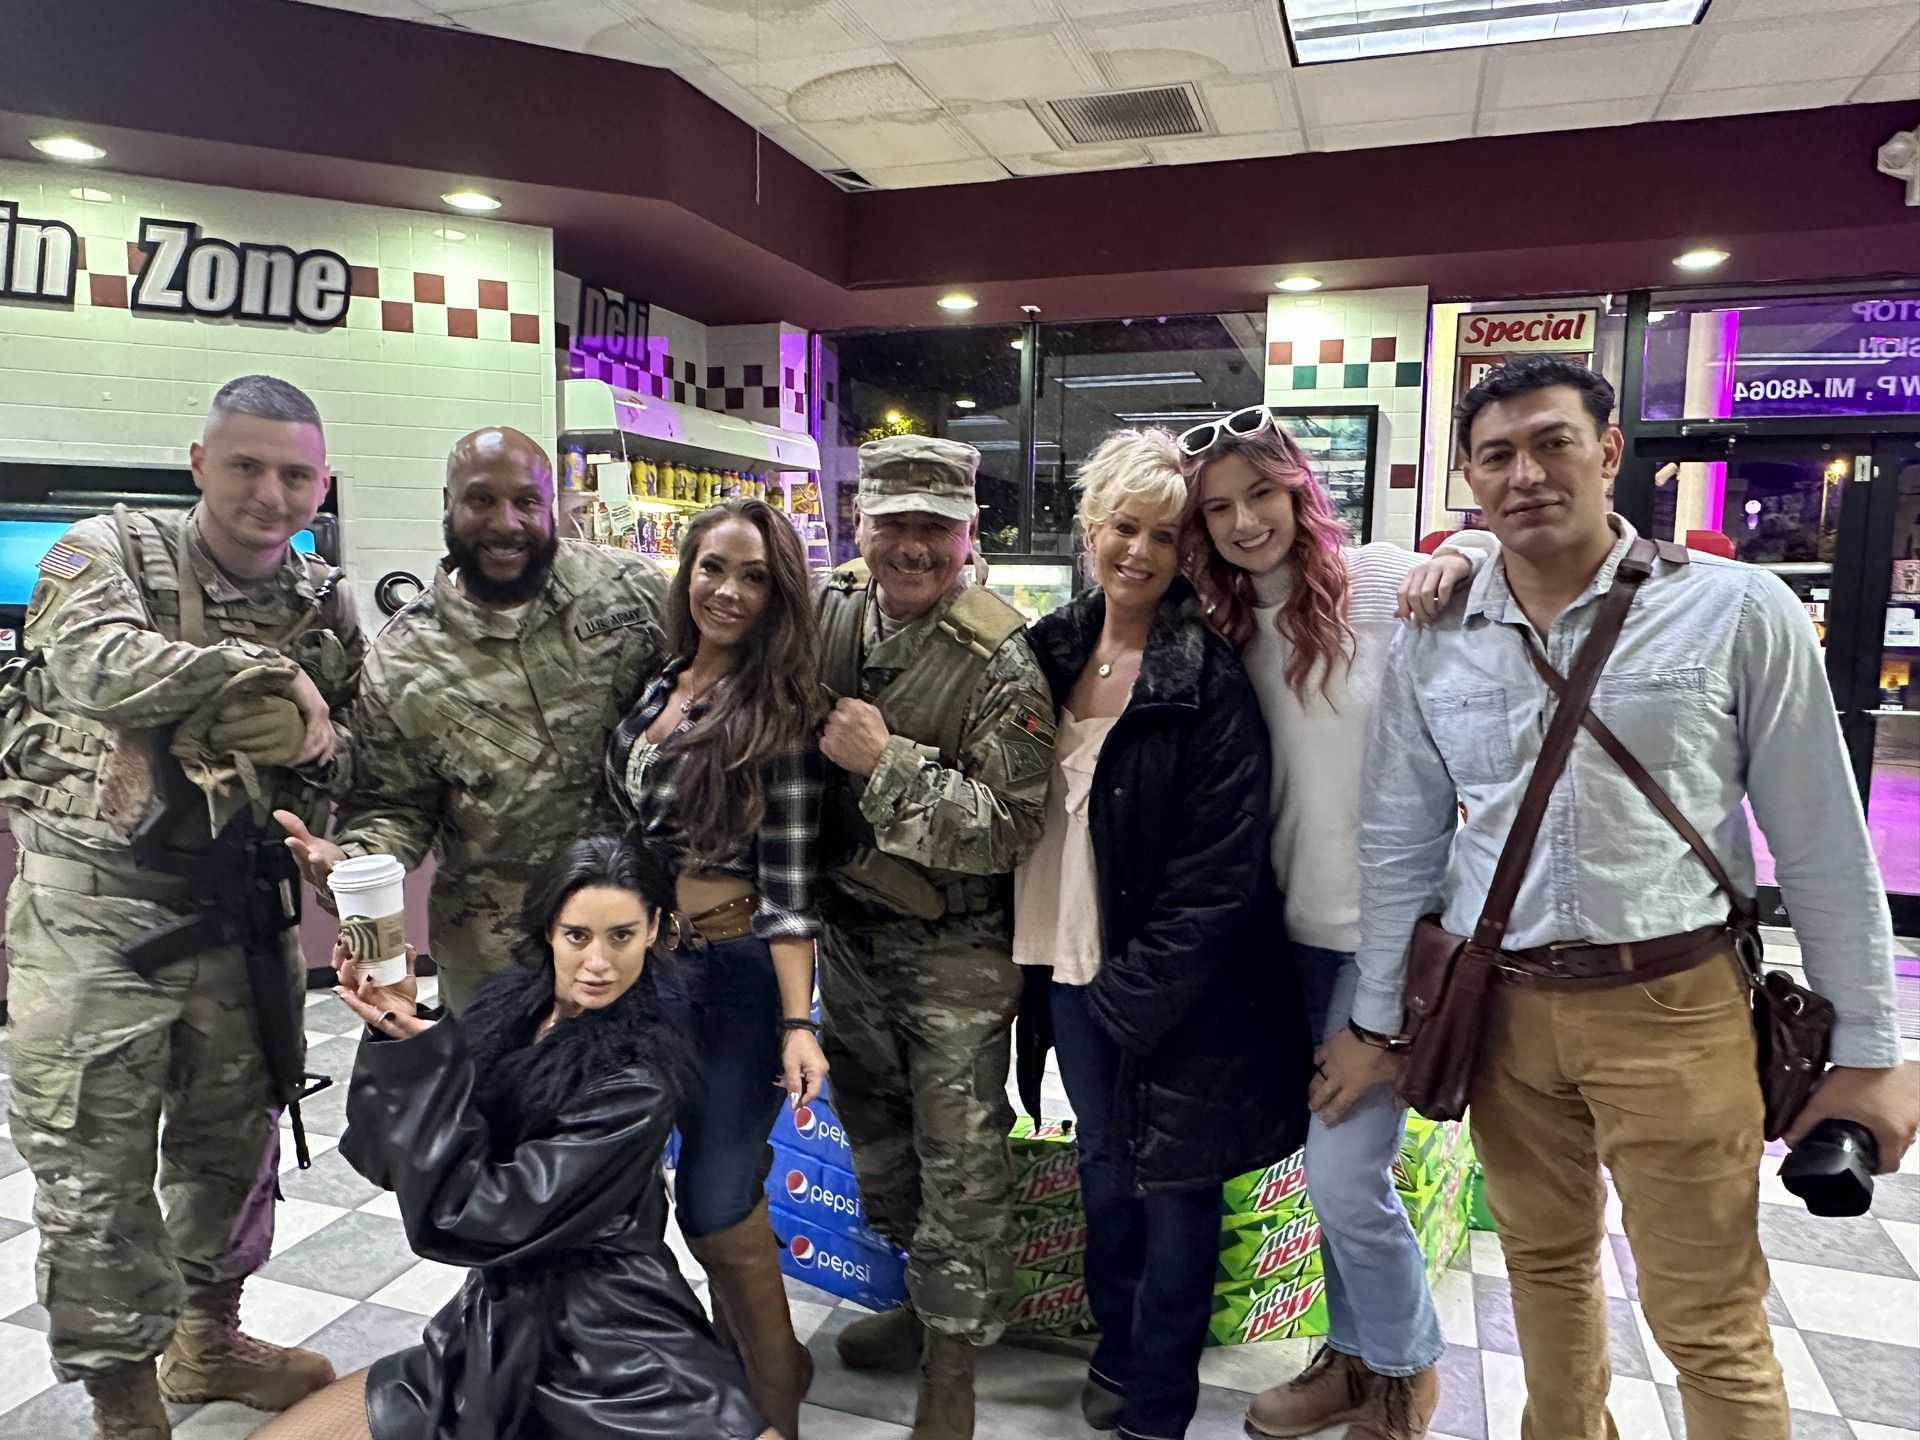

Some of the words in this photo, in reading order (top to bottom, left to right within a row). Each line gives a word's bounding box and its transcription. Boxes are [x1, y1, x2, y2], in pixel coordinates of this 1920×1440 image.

[135, 220, 349, 324] Zone
[581, 285, 648, 362] Deli
[1464, 313, 1586, 346] Special
[611, 608, 640, 625] ARMY
[818, 1121, 850, 1148] pep
[811, 1185, 859, 1217] pepsi
[817, 1250, 870, 1283] pepsi
